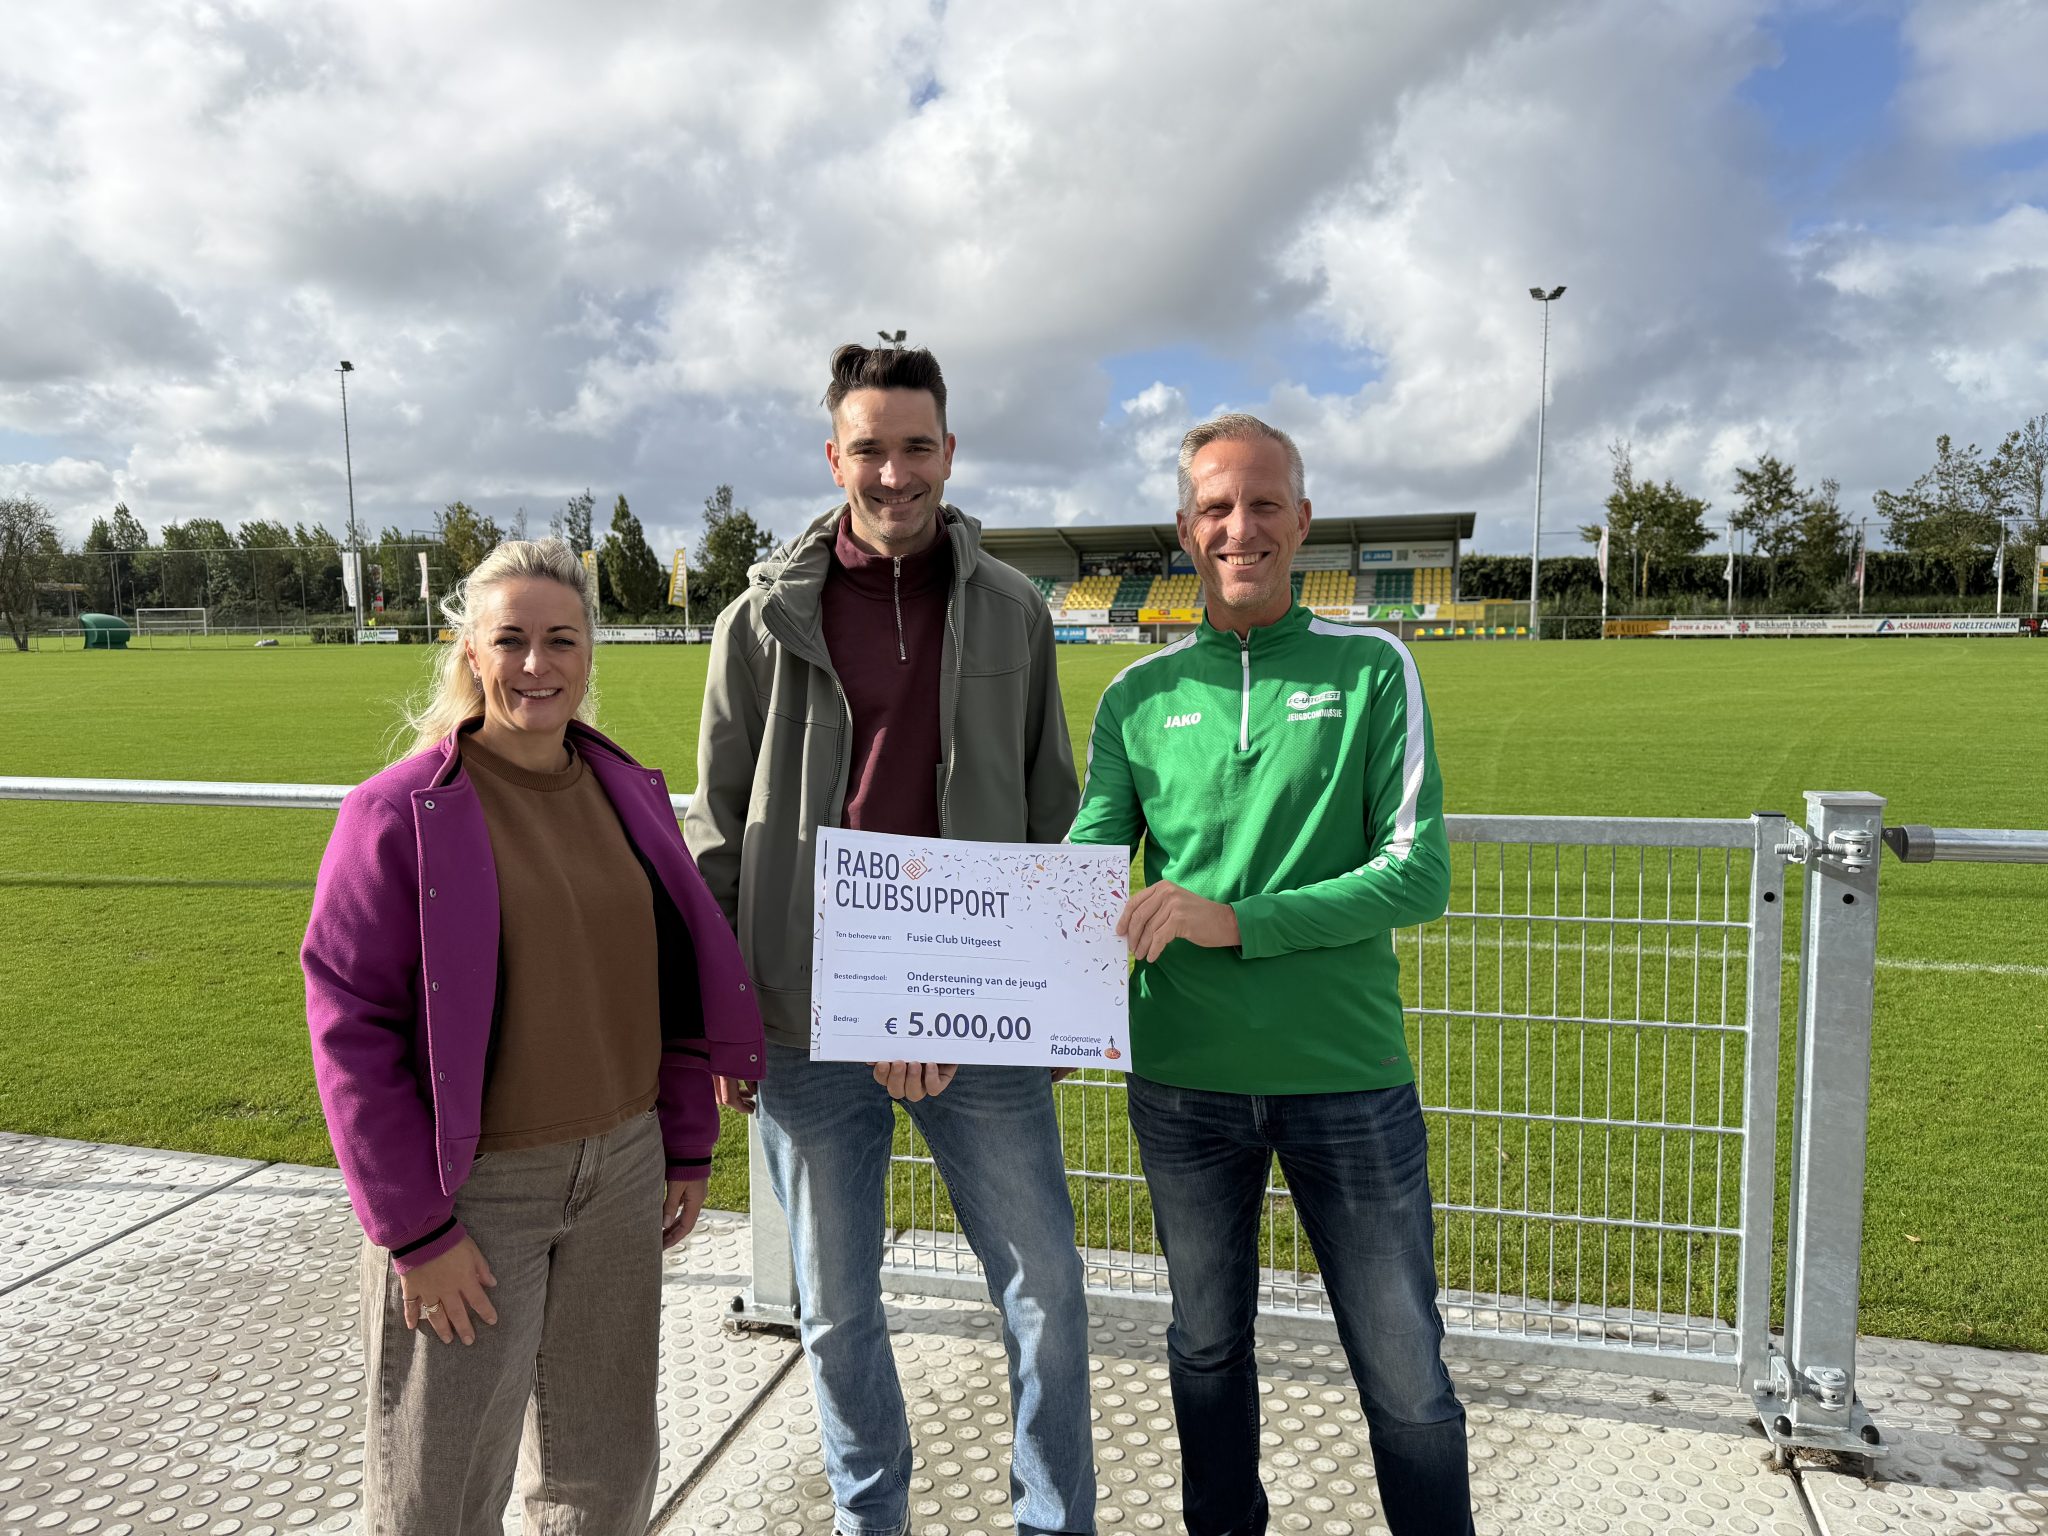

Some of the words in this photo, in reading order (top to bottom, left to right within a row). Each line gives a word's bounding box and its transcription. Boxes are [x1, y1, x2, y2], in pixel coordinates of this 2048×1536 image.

[1953, 621, 2017, 629] KOELTECHNIEK
[1164, 712, 1201, 728] JAKO
[837, 848, 900, 881] RABO
[835, 879, 1009, 919] CLUBSUPPORT
[848, 931, 876, 941] behoeve
[907, 933, 933, 943] Fusie
[935, 933, 958, 945] Club
[961, 935, 1001, 949] Uitgeest
[834, 972, 888, 981] Bestedingsdoel:
[907, 972, 982, 985] Ondersteuning
[985, 977, 1003, 985] van
[1006, 975, 1018, 986] de
[1019, 977, 1047, 990] jeugd
[923, 985, 975, 996] G-sporters
[833, 1015, 859, 1024] Bedrag:
[885, 1018, 897, 1035] €
[908, 1012, 1031, 1043] 5.000,00
[1060, 1035, 1101, 1045] coöperatieve
[1051, 1045, 1102, 1057] Rabobank
